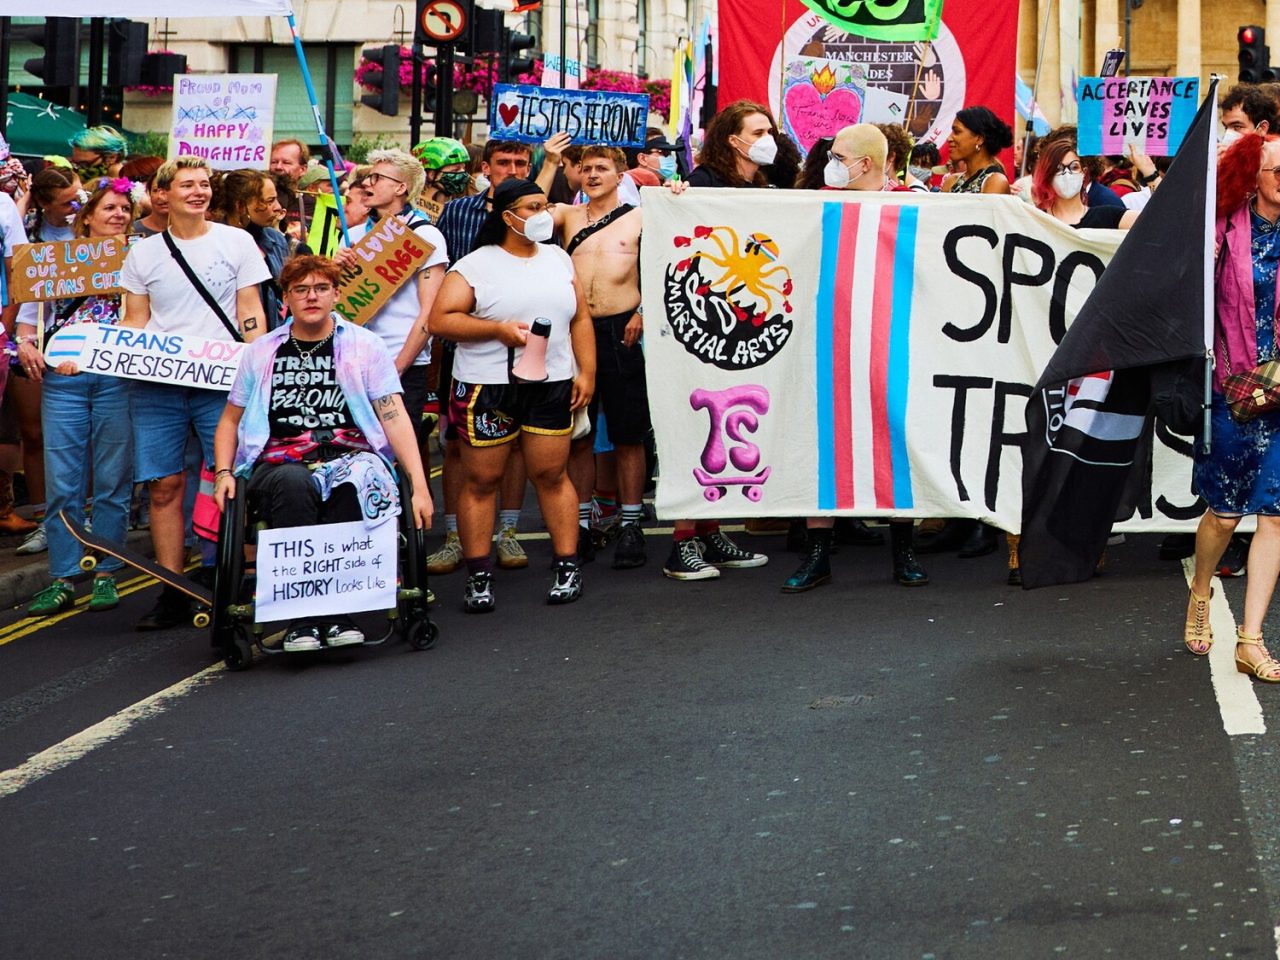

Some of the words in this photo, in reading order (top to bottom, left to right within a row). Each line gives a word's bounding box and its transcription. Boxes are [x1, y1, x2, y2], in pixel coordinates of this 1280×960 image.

[825, 51, 914, 62] MANCHESTER
[213, 96, 232, 106] OF
[1113, 100, 1171, 119] SAVES
[517, 95, 645, 142] TESTOSTERONE
[1109, 121, 1168, 139] LIVES
[194, 123, 249, 139] HAPPY
[179, 141, 266, 161] DAUGHTER
[357, 217, 405, 262] LOVE
[31, 245, 56, 263] WE
[65, 239, 116, 264] LOVE
[26, 263, 58, 278] OUR
[335, 278, 381, 321] RANS
[375, 240, 424, 285] RAGE
[30, 276, 85, 298] TRANS
[92, 270, 121, 289] CHI
[942, 224, 1107, 346] SPO
[668, 281, 727, 361] MARTIAL
[732, 324, 789, 364] ARTS
[98, 327, 183, 354] TRANS
[188, 341, 242, 361] JOY
[87, 349, 112, 371] IS
[114, 353, 236, 386] RESISTANCE
[274, 355, 337, 371] TRAN
[277, 412, 346, 428] PORT
[301, 407, 316, 415] IN
[269, 539, 315, 558] THIS
[324, 542, 334, 554] is
[342, 535, 374, 553] what
[272, 566, 297, 577] the
[303, 557, 344, 574] RIGHT
[344, 556, 366, 570] side
[371, 554, 382, 569] of
[273, 577, 333, 601] HISTORY
